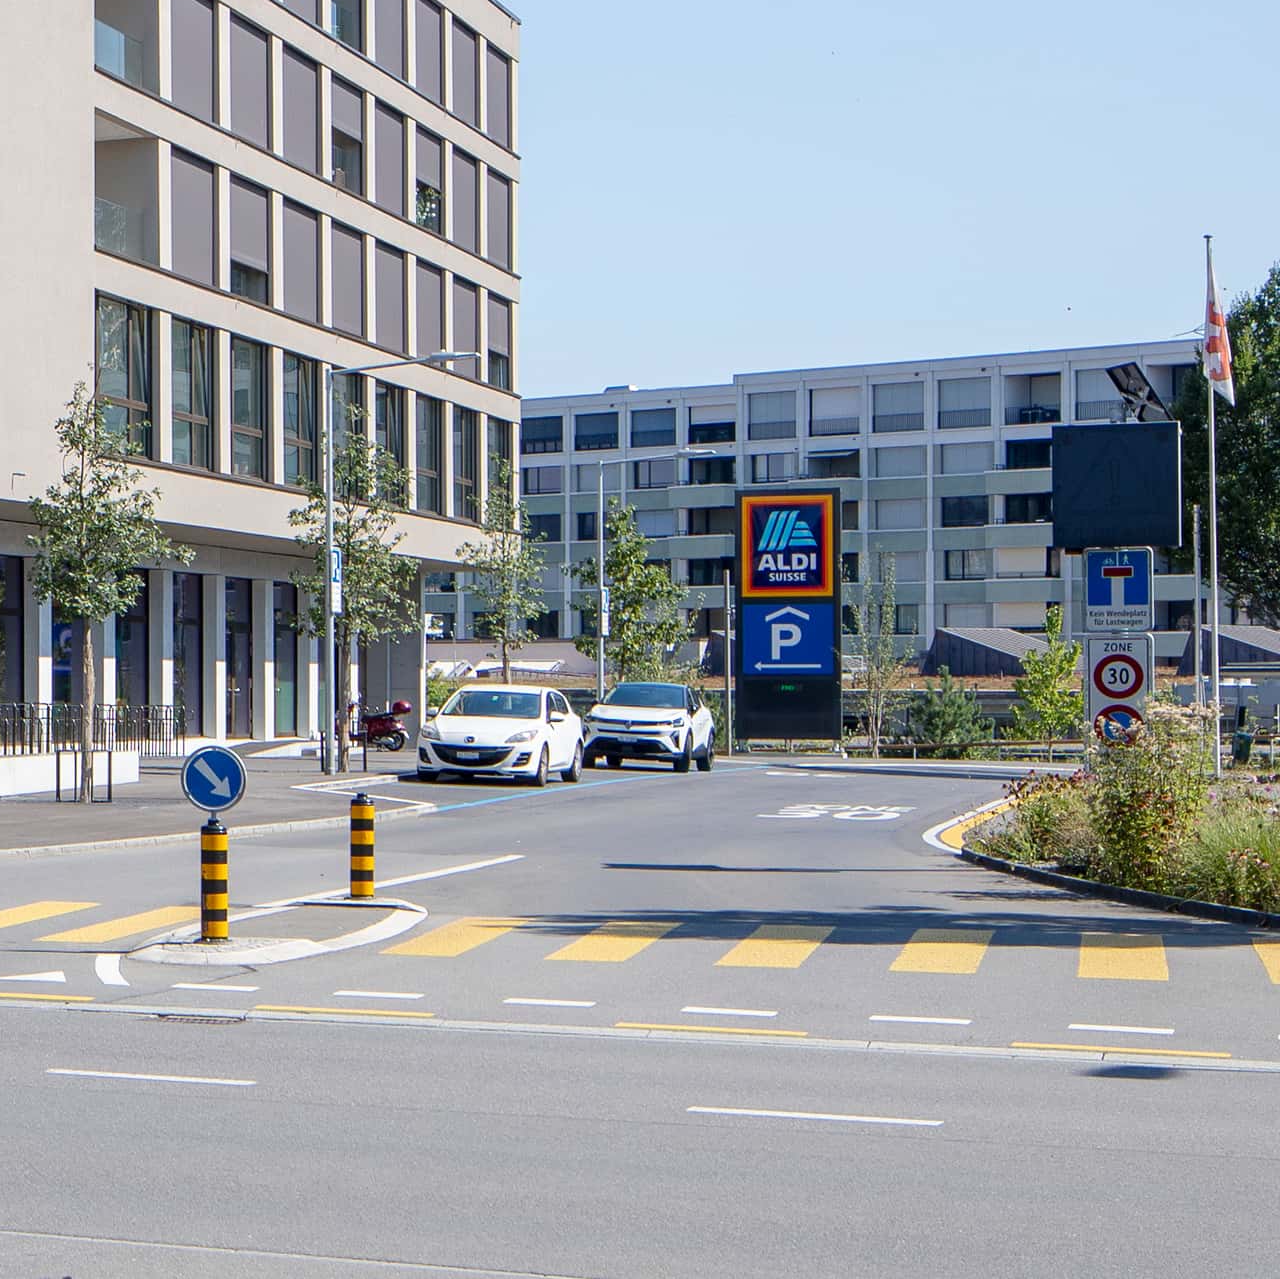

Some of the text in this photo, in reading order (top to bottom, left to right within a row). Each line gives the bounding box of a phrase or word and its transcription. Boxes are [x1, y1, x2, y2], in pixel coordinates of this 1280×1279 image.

[757, 553, 817, 571] ALDI
[769, 571, 807, 582] SUISSE
[771, 623, 803, 661] P
[1103, 642, 1134, 653] ZONE
[1108, 667, 1130, 685] 30
[756, 808, 901, 821] 30
